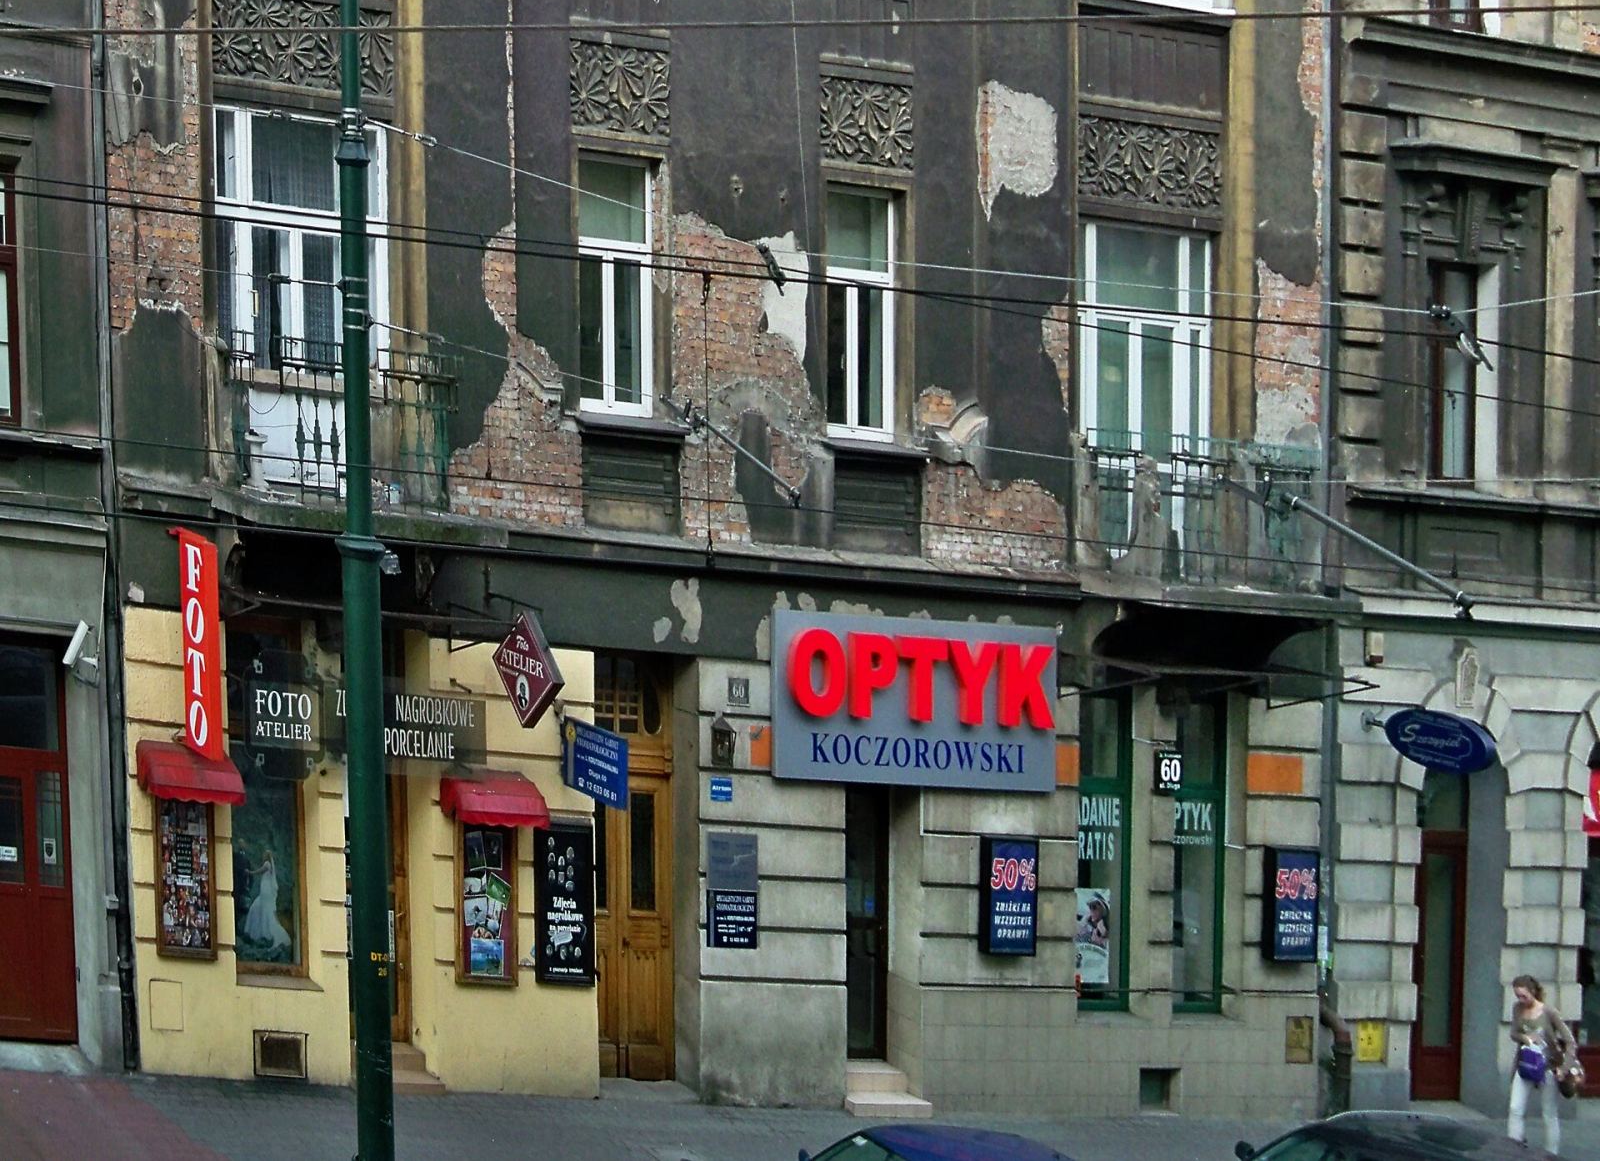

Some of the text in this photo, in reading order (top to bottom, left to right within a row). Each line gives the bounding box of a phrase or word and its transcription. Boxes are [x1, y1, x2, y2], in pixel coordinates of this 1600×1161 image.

[184, 542, 208, 747] FOTO
[500, 648, 544, 678] ATELIER
[787, 627, 1055, 730] OPTYK
[255, 689, 312, 720] FOTO
[733, 685, 744, 698] 60
[395, 694, 475, 727] NAGROBKOWE
[255, 720, 312, 742] ATELIER
[384, 728, 455, 759] PORCELANIE
[811, 733, 1024, 774] KOCZOROWSKI
[1161, 759, 1180, 781] 60
[991, 858, 1036, 891] 50%
[1275, 868, 1317, 900] 50%
[994, 915, 1032, 926] WSZYSTKIE
[1021, 902, 1031, 912] NA
